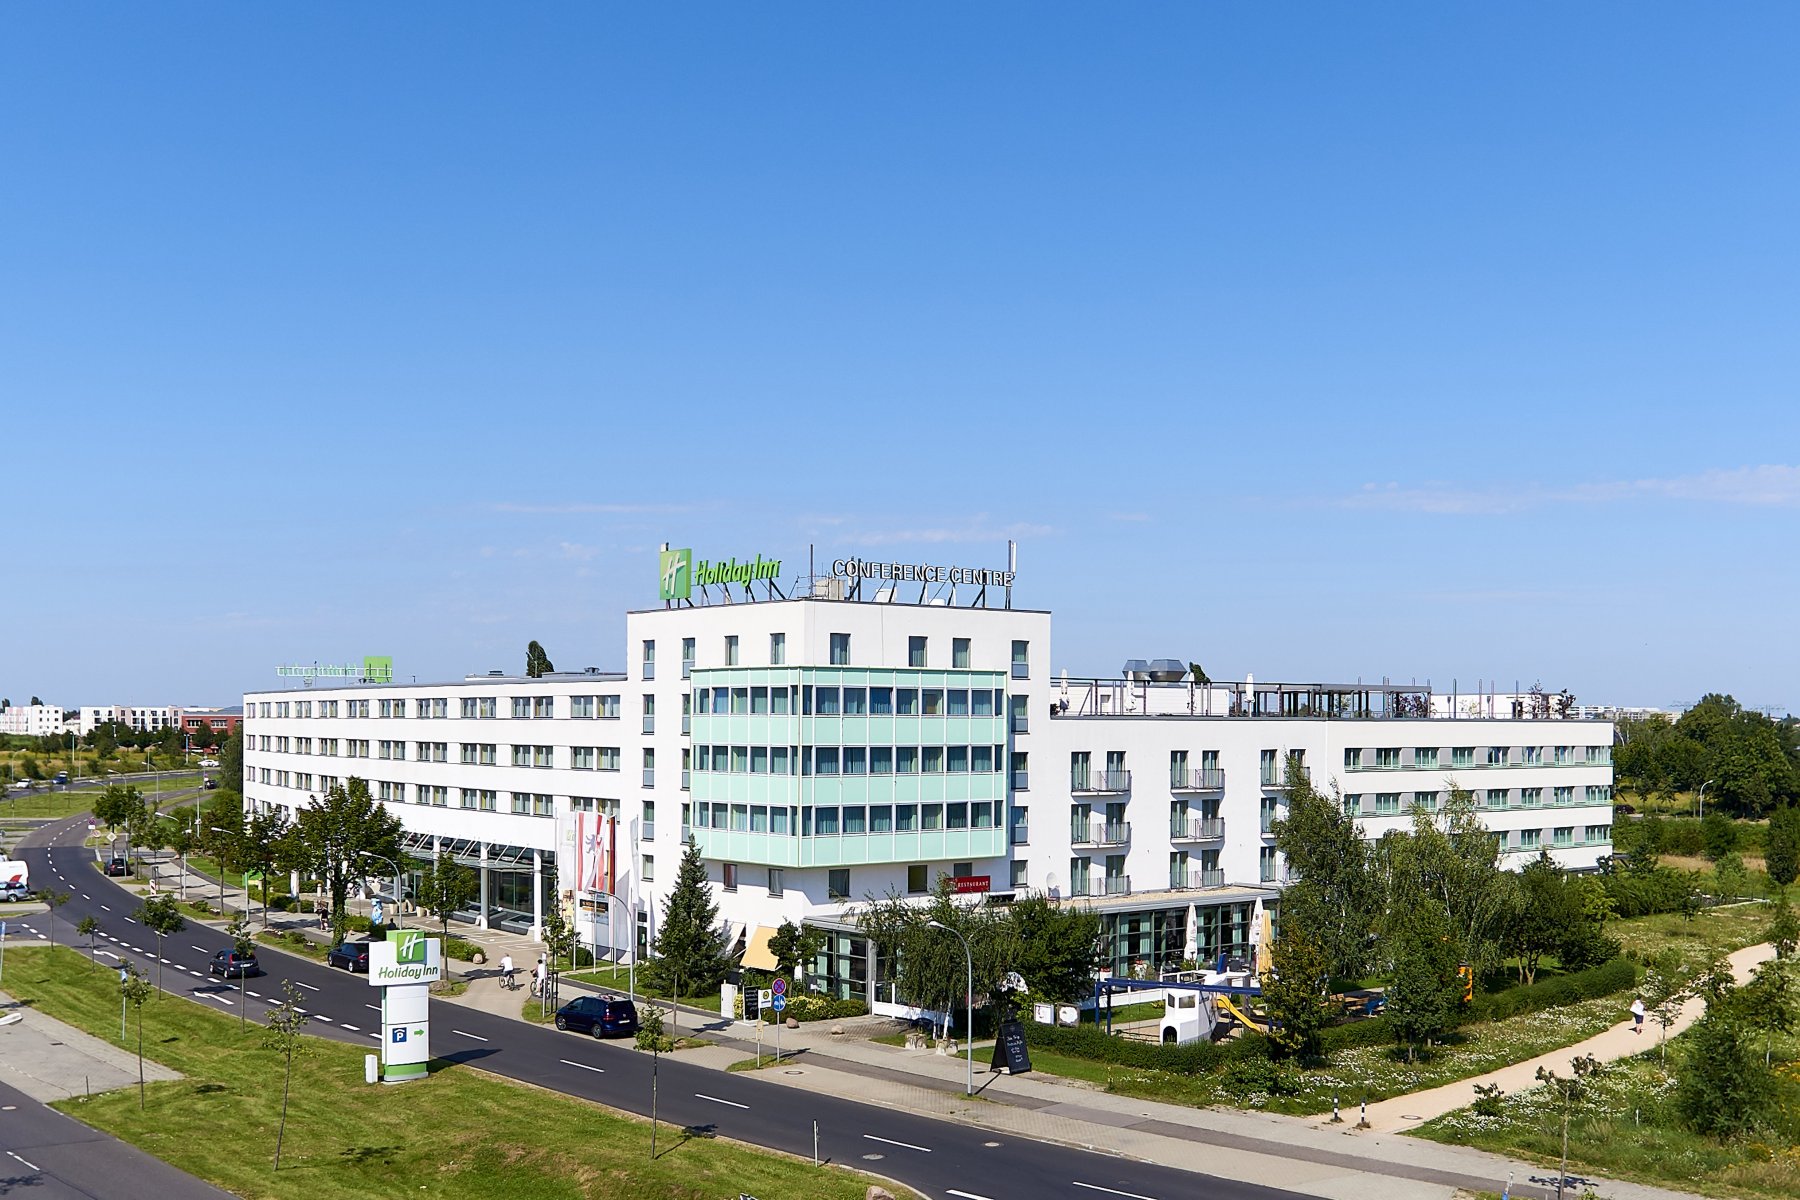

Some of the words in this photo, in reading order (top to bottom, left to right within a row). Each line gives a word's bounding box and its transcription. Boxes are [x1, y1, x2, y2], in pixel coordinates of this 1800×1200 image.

[695, 557, 754, 588] Holiday
[755, 553, 782, 580] Inn
[833, 559, 946, 583] CONFERENCE
[950, 567, 1014, 588] CENTRE
[957, 880, 989, 888] RESTAURANT
[400, 933, 424, 960] H
[379, 965, 421, 980] Holiday
[422, 965, 439, 976] Inn
